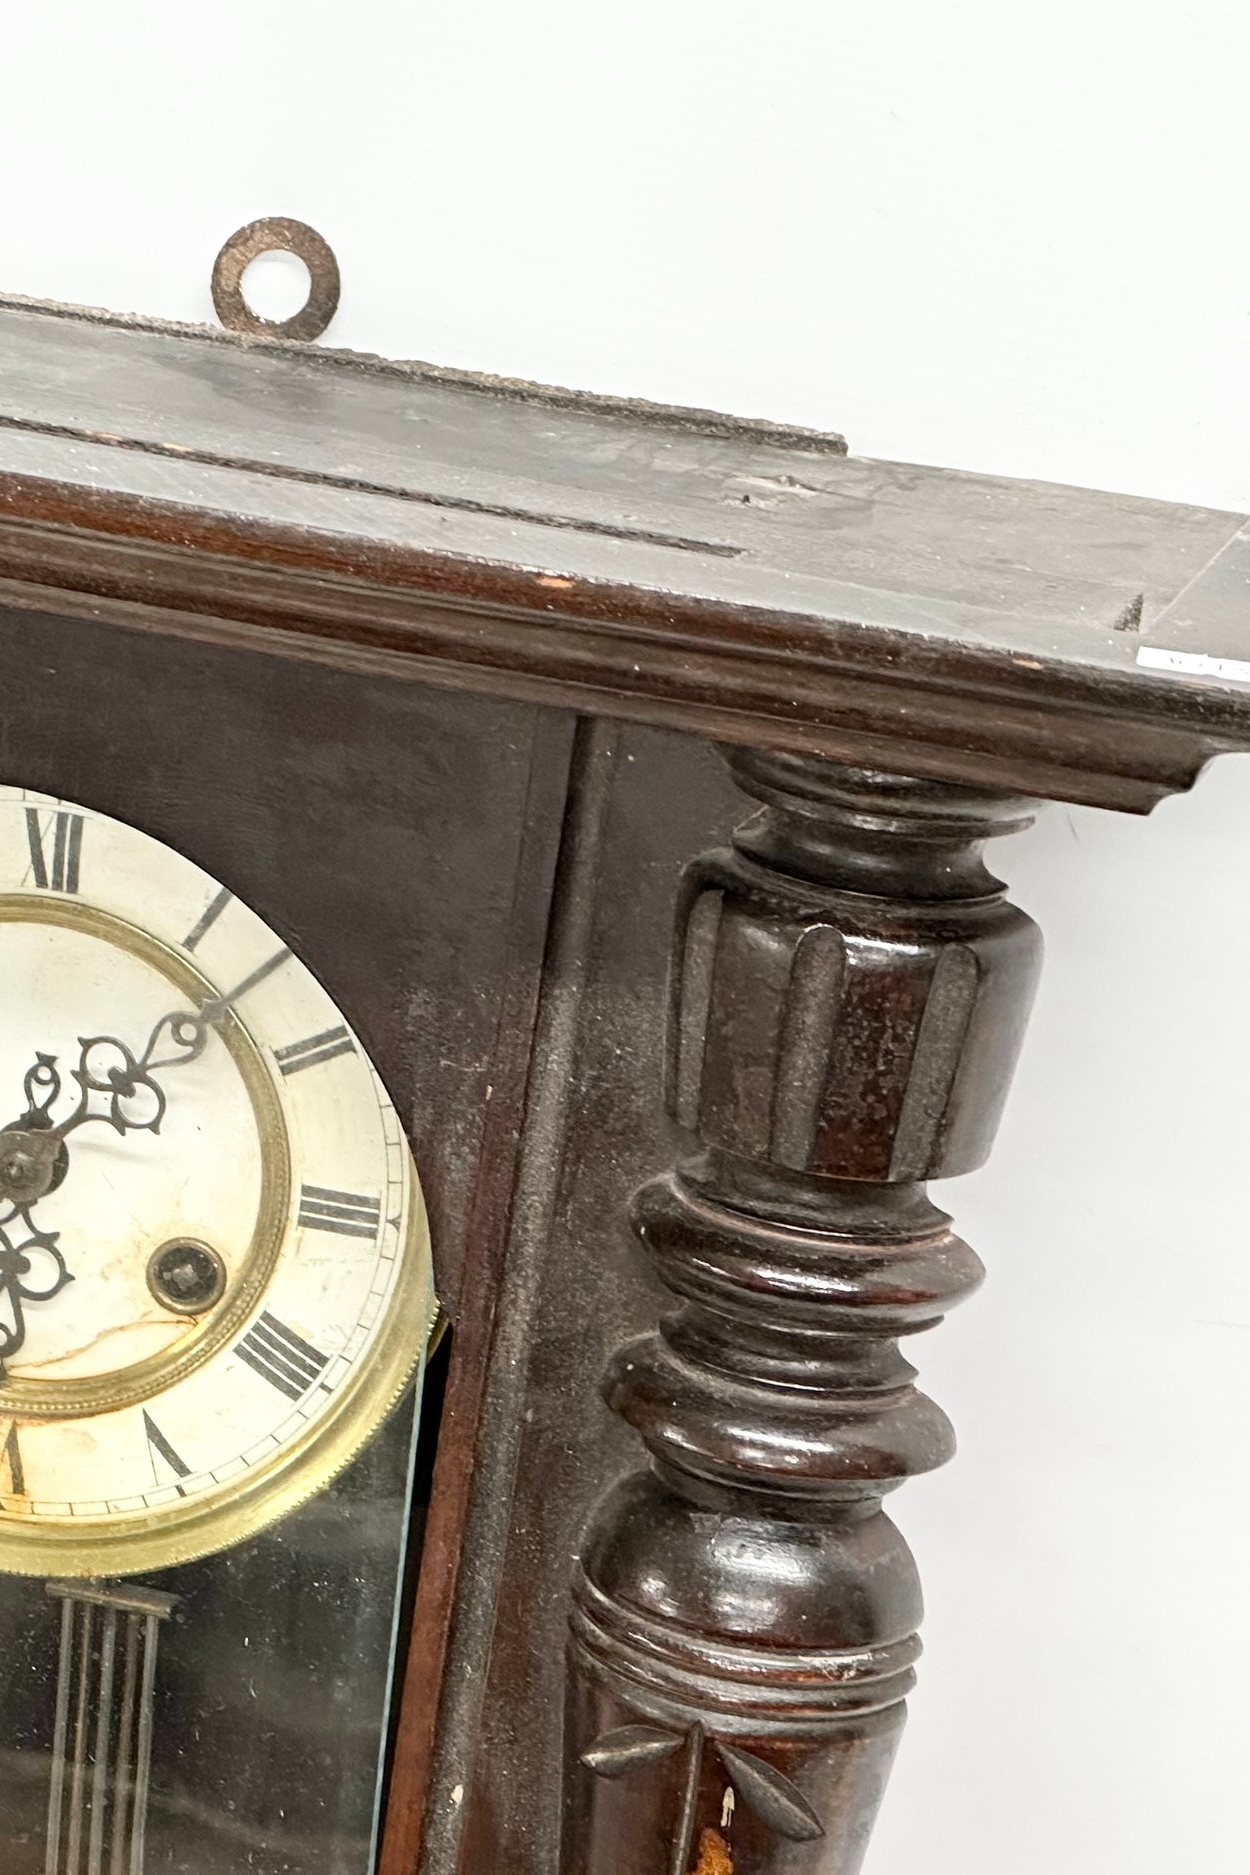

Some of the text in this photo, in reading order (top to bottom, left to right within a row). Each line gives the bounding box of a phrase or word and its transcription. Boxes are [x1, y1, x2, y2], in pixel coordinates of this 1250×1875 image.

[21, 807, 85, 894] XII
[272, 1021, 359, 1077] II
[297, 1183, 382, 1241] III
[232, 1309, 333, 1403] IIII
[142, 1406, 195, 1487] V
